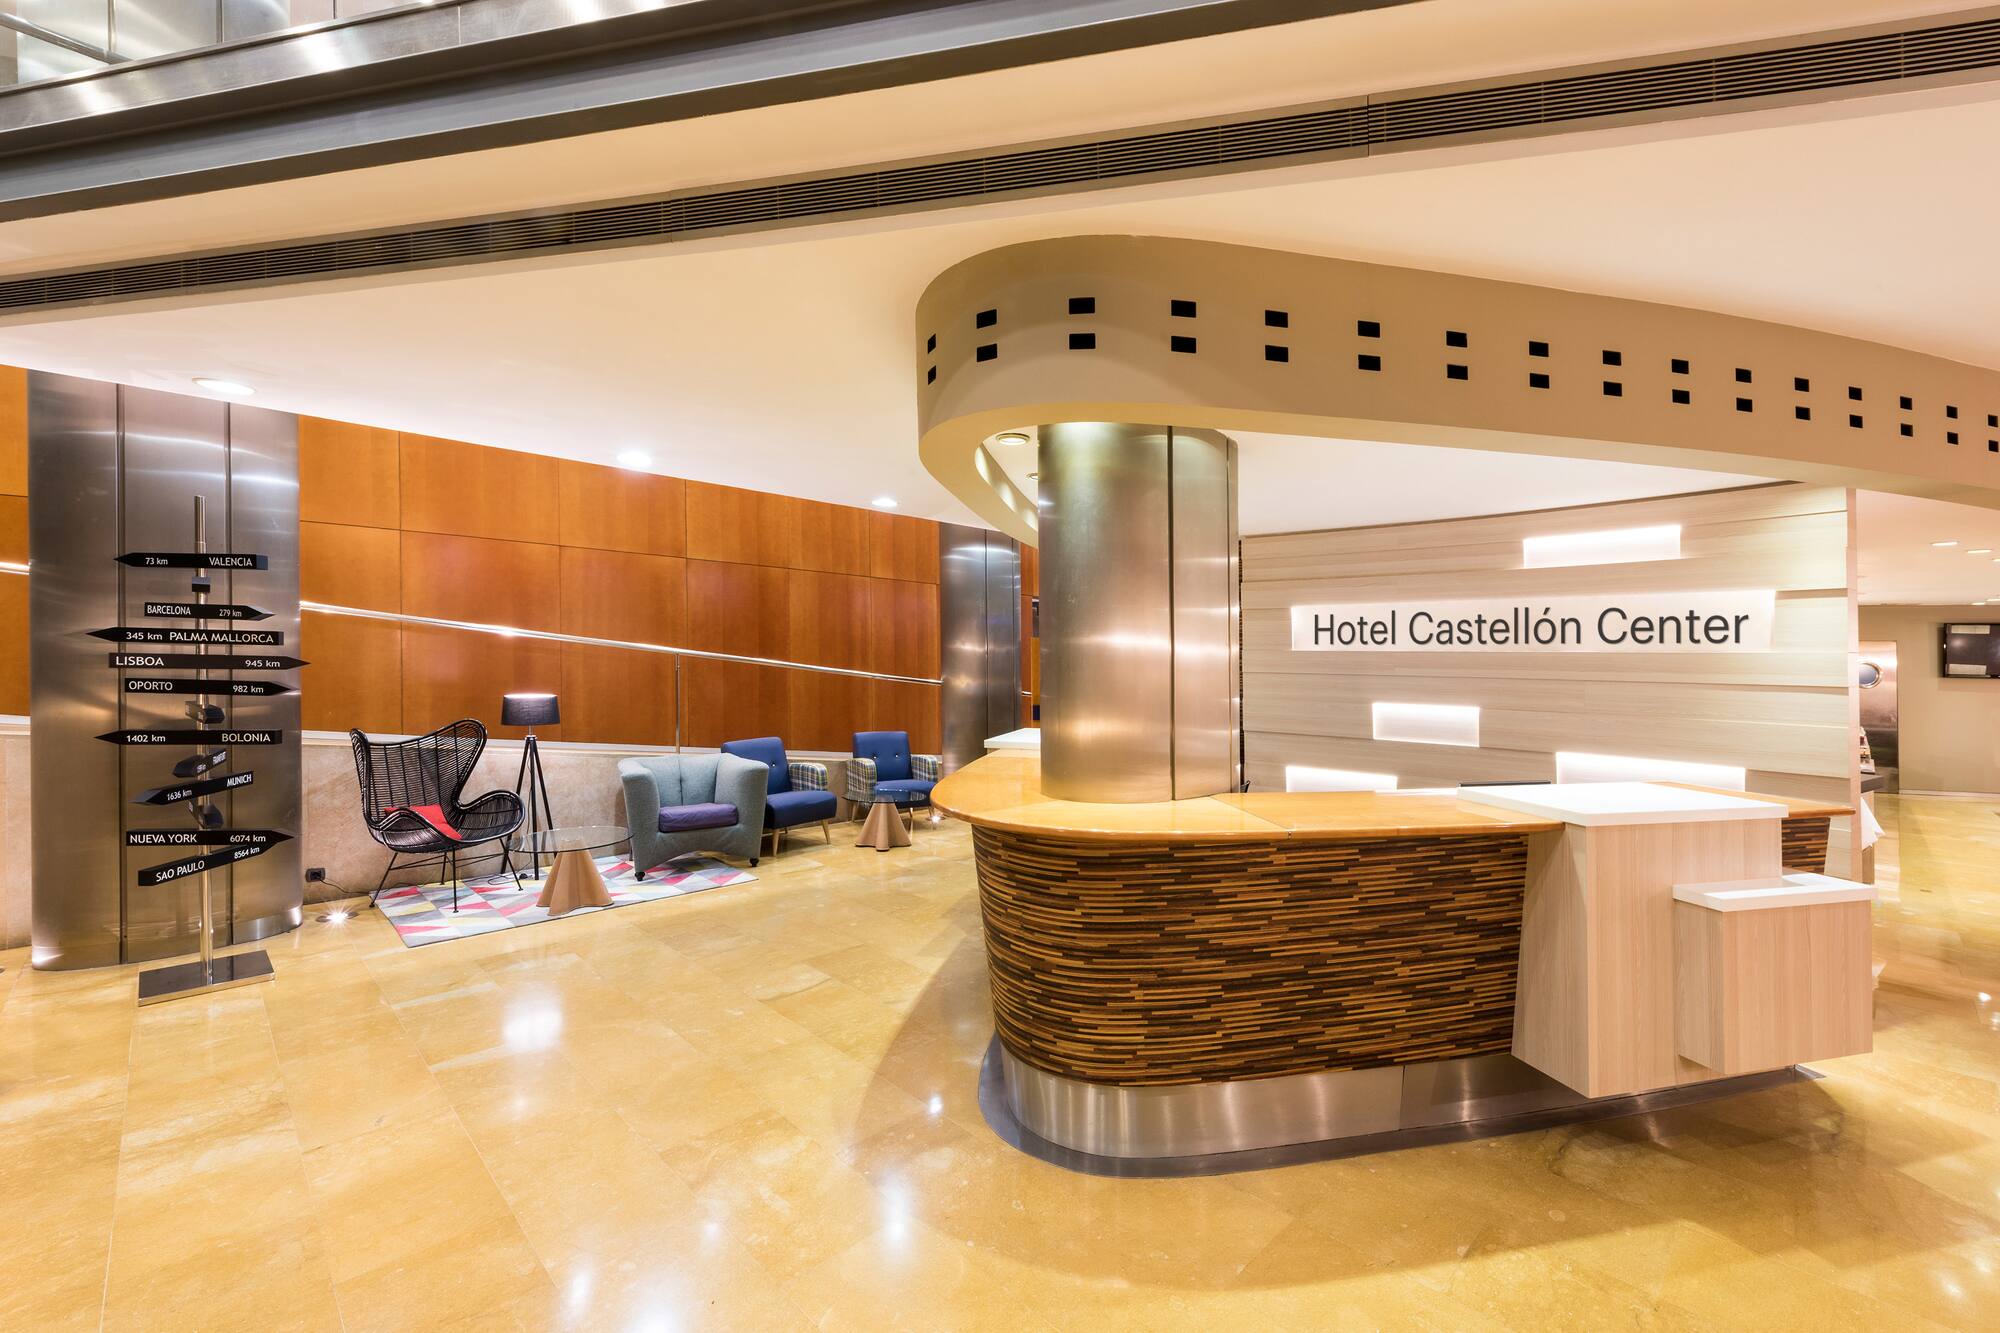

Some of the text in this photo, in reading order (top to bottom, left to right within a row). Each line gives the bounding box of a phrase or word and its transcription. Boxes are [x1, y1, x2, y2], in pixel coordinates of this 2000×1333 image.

[145, 557, 253, 567] 73 km VALENCIA
[147, 605, 242, 617] BARCELONA 279 km
[1313, 607, 1750, 645] Hotel Castellón Center
[126, 631, 274, 643] 345 km PALMA MALLORCA
[115, 656, 281, 667] LISBOA 945 km
[128, 680, 264, 693] OPORTO 982 km
[126, 733, 271, 742] 1402 km BOLONIA
[166, 773, 252, 801] 1636 km MUNICH
[129, 833, 266, 843] NUEVA YORK 6074 km
[155, 846, 260, 882] SAO PAULO 8564 km
